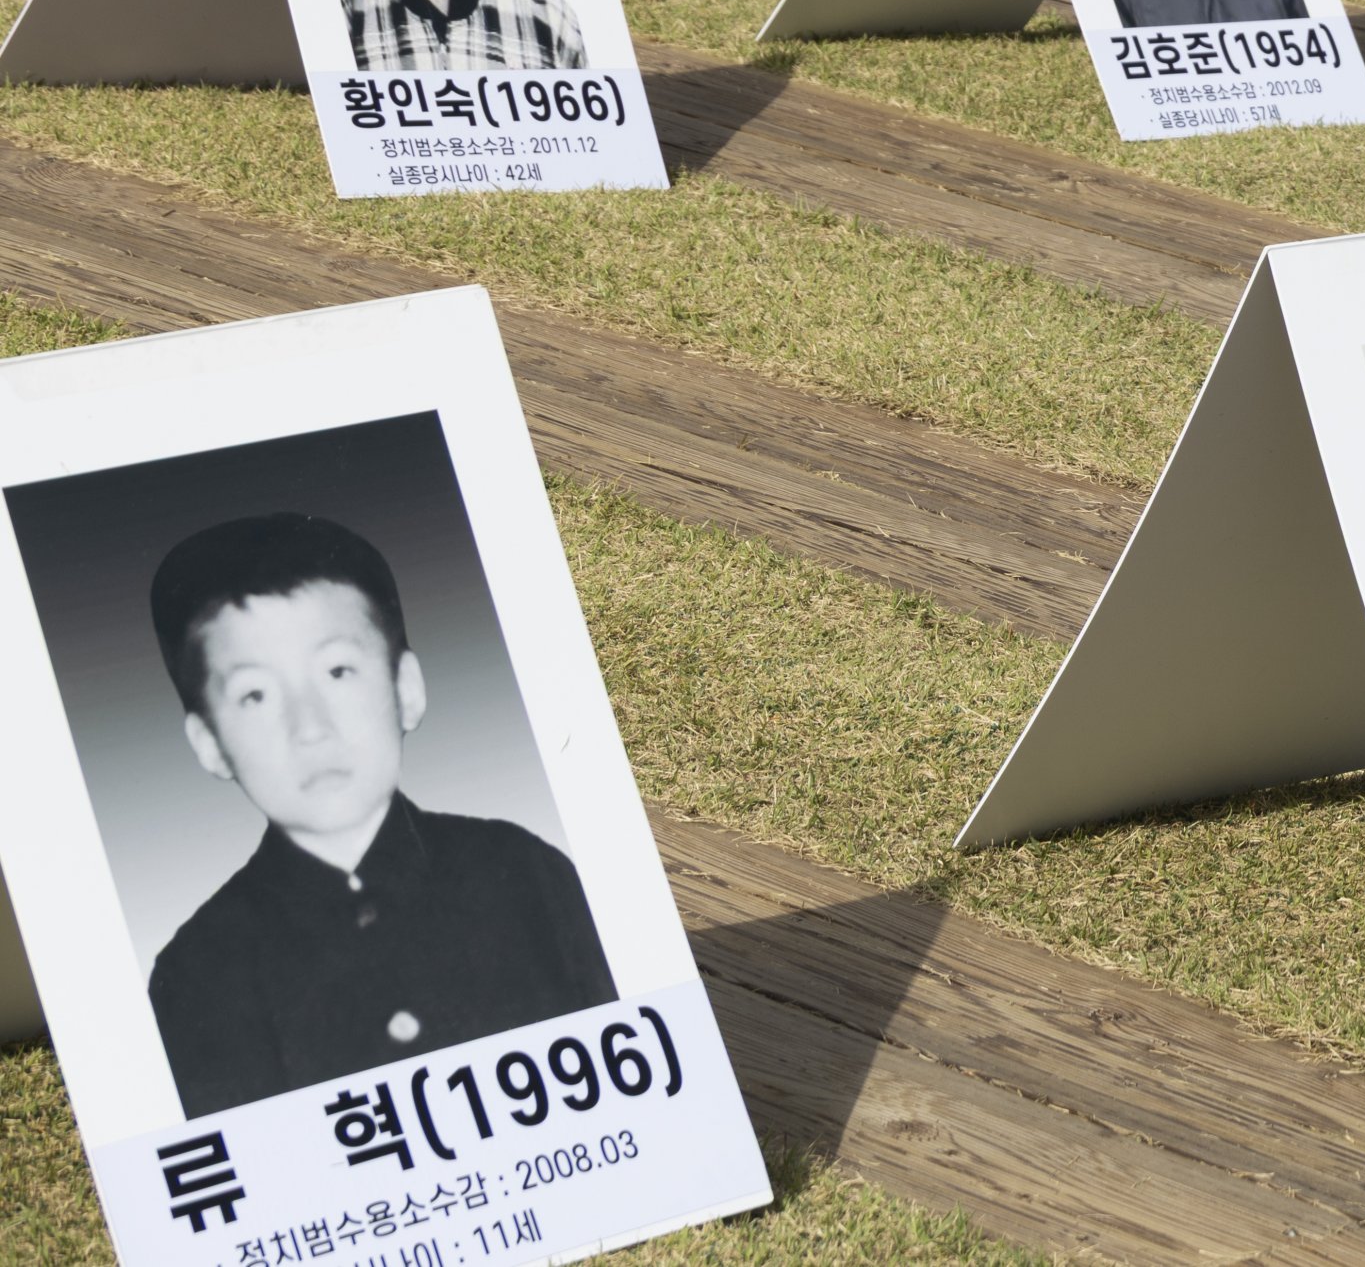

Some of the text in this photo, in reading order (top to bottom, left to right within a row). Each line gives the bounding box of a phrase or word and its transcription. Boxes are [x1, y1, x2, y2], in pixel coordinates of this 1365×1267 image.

[1111, 23, 1340, 79] 김호준(1954)
[341, 75, 625, 129] 황인숙(1966)
[1149, 82, 1256, 105] 정치범수용소수감
[1267, 79, 1322, 96] 2012.09
[1159, 107, 1239, 129] 실종당시나이
[1250, 104, 1281, 121] 57세
[381, 137, 515, 157] 정치범수용소수감
[531, 136, 598, 153] 2011.12
[388, 164, 488, 185] 실종당시나이
[506, 163, 542, 181] 42세
[157, 1005, 683, 1234] 류 혁(1996)
[236, 1172, 488, 1267] 정치범수용소수감
[515, 1130, 640, 1191] 2008.03
[473, 1208, 542, 1256] 11세
